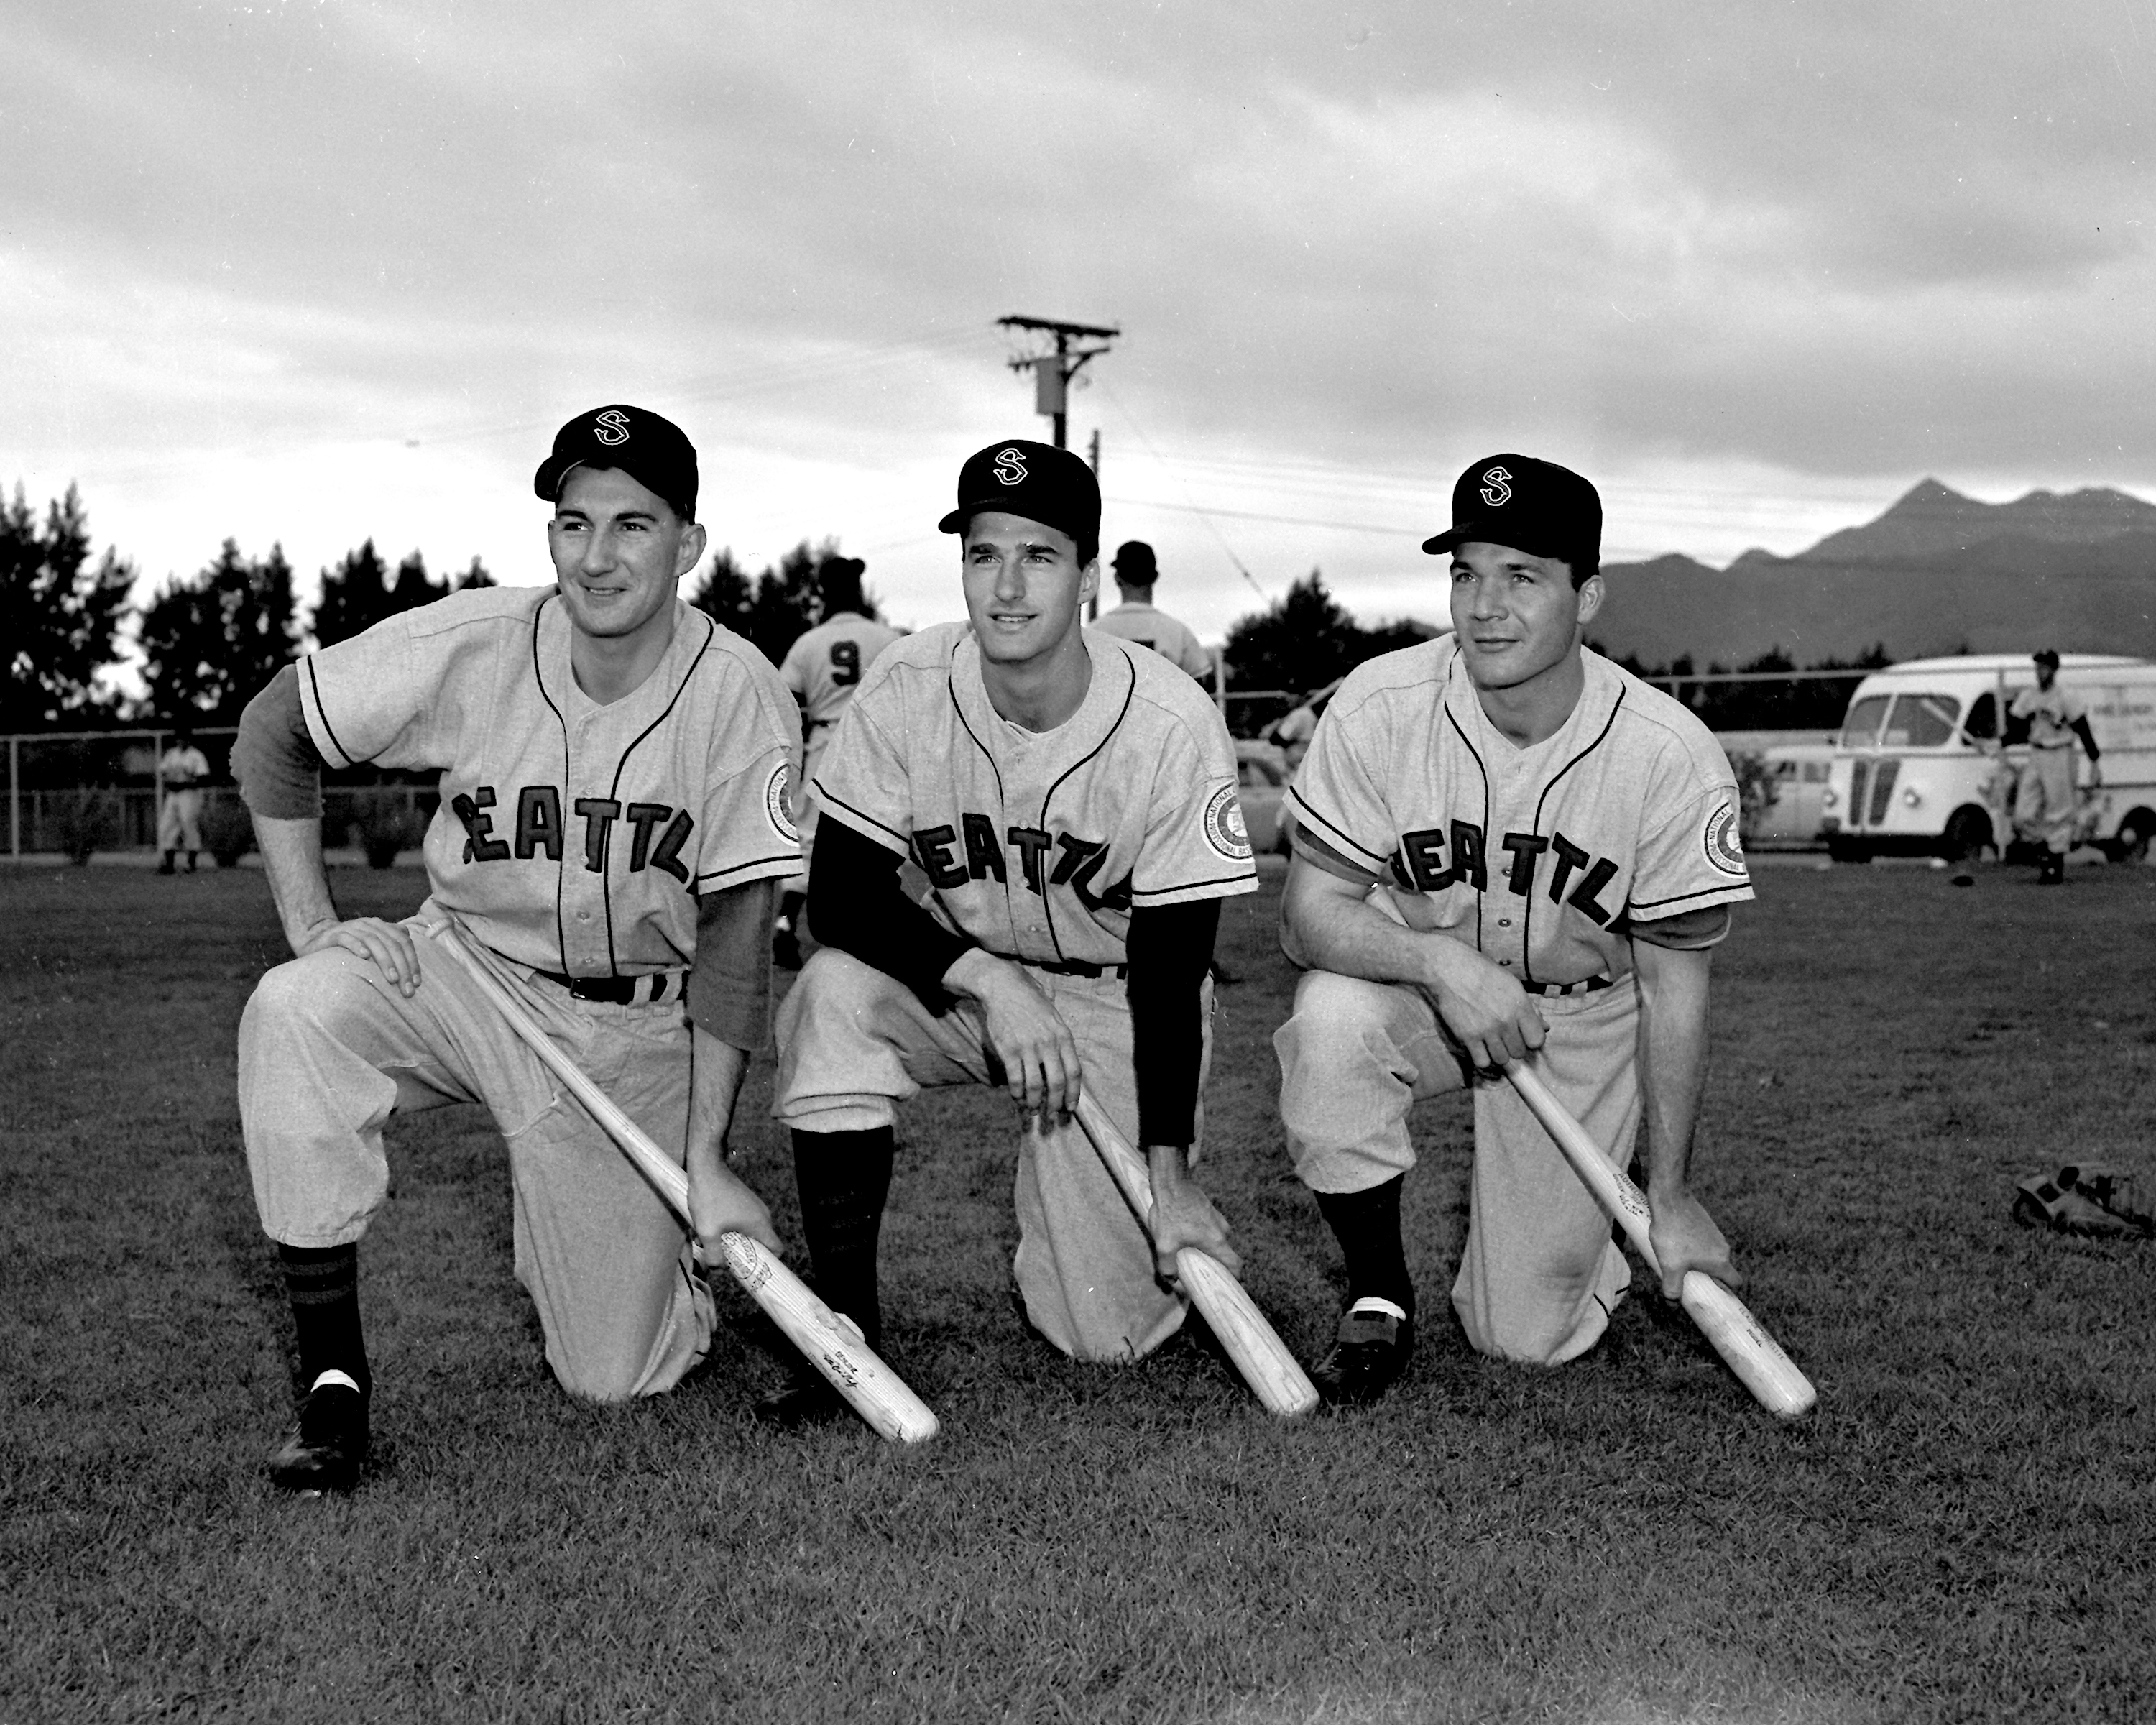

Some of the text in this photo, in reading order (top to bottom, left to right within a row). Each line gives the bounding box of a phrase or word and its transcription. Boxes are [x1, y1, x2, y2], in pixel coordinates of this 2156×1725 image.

[594, 410, 630, 446] S
[993, 448, 1028, 485] S
[1480, 466, 1513, 506] S
[831, 640, 860, 686] 9
[770, 770, 788, 801] NATIONA
[1207, 790, 1233, 818] NATIONAL
[451, 786, 696, 894] EATTL
[1708, 809, 1731, 840] NATIONAL
[909, 812, 1132, 911] EATTL
[1390, 818, 1629, 933] EATTL
[1618, 1173, 1650, 1208] ADIROND
[1746, 1328, 1762, 1348] MODEL
